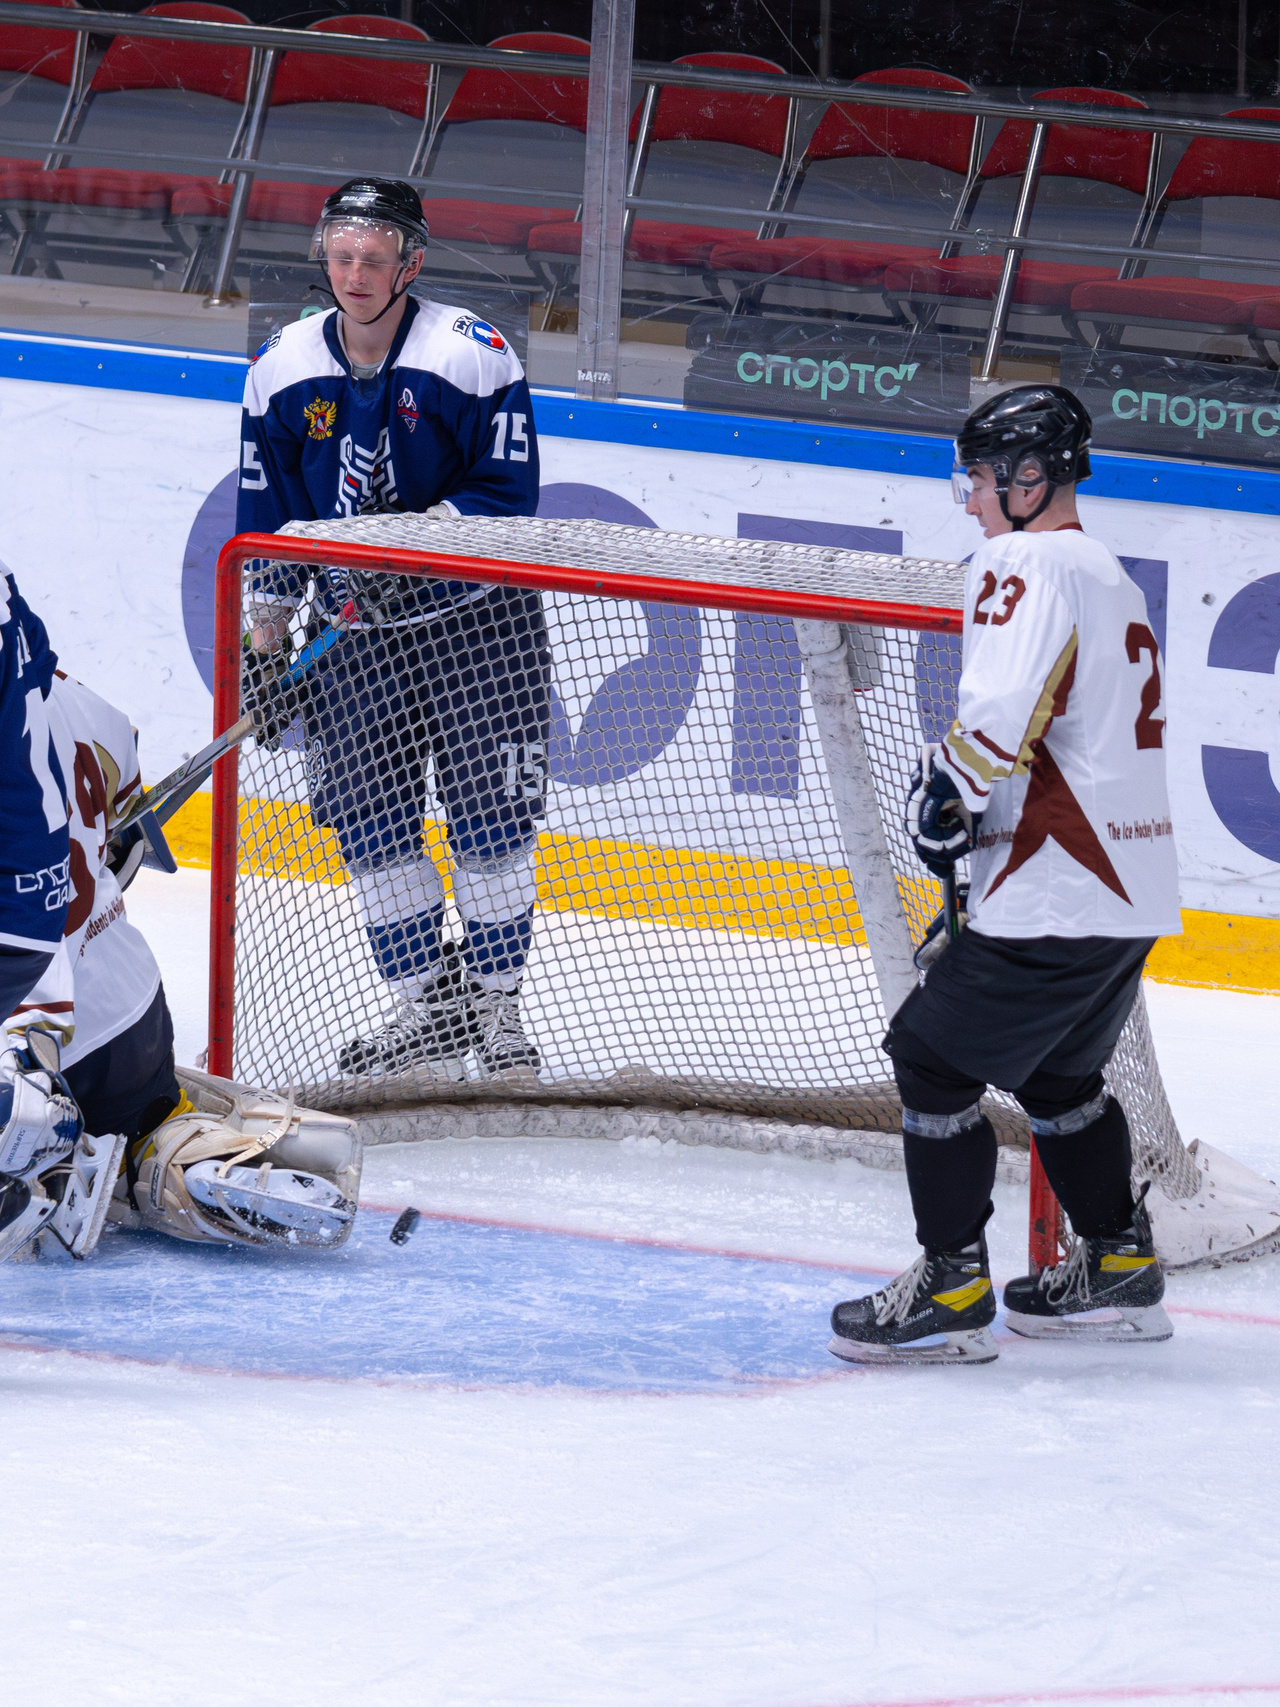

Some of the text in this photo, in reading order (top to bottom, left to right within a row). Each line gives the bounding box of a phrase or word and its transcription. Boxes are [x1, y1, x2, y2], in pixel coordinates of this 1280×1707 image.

[491, 412, 529, 462] 15
[237, 441, 268, 491] 5
[974, 569, 1027, 626] 23
[1125, 622, 1167, 750] 2
[898, 1306, 934, 1328] BAUER
